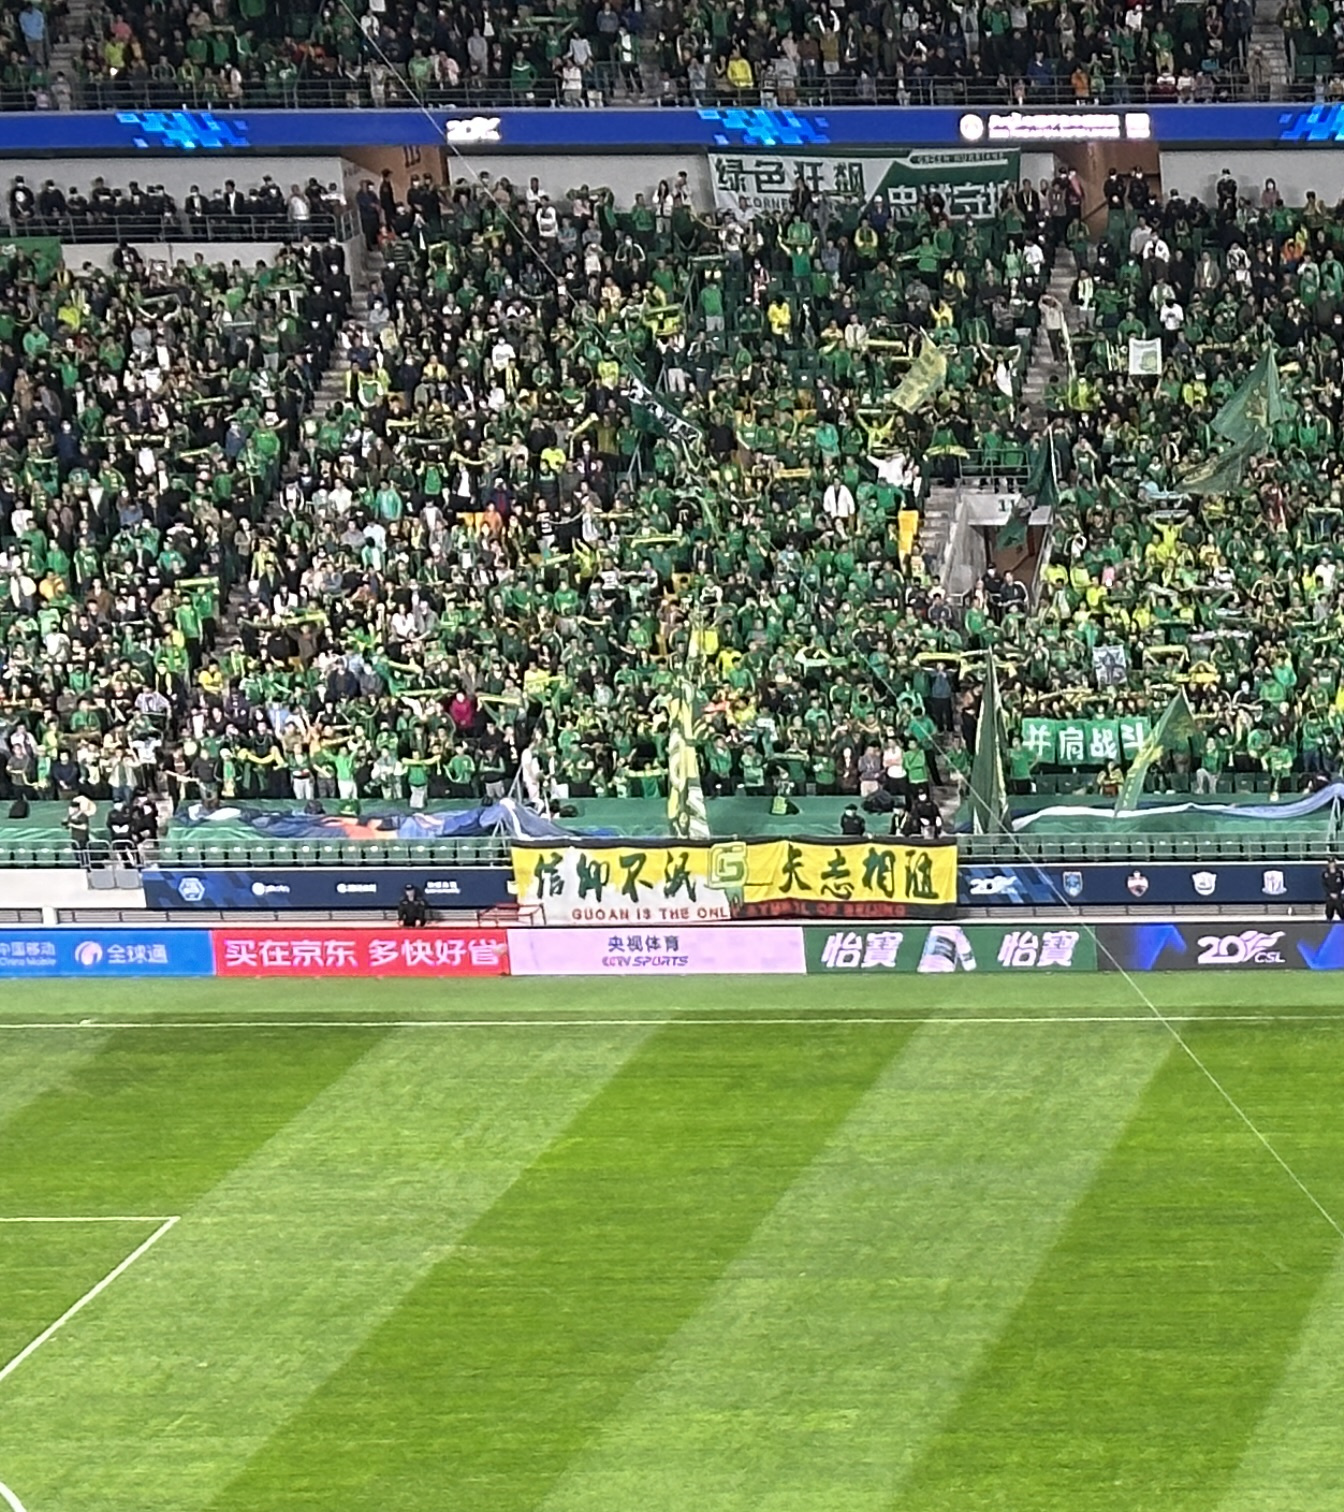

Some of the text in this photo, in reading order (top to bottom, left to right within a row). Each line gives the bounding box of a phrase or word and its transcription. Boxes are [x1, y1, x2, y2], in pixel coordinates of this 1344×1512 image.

[1022, 723, 1147, 761] 并肩战斗
[572, 908, 629, 920] GUOAN
[637, 908, 651, 920] IS
[659, 908, 690, 920] THE
[107, 944, 168, 964] 全球通
[225, 939, 500, 967] 买在京东 多快好省
[608, 935, 680, 952] 央视体育
[821, 931, 903, 968] 怡寶
[998, 930, 1080, 968] 怡寶
[1255, 952, 1286, 963] CSL
